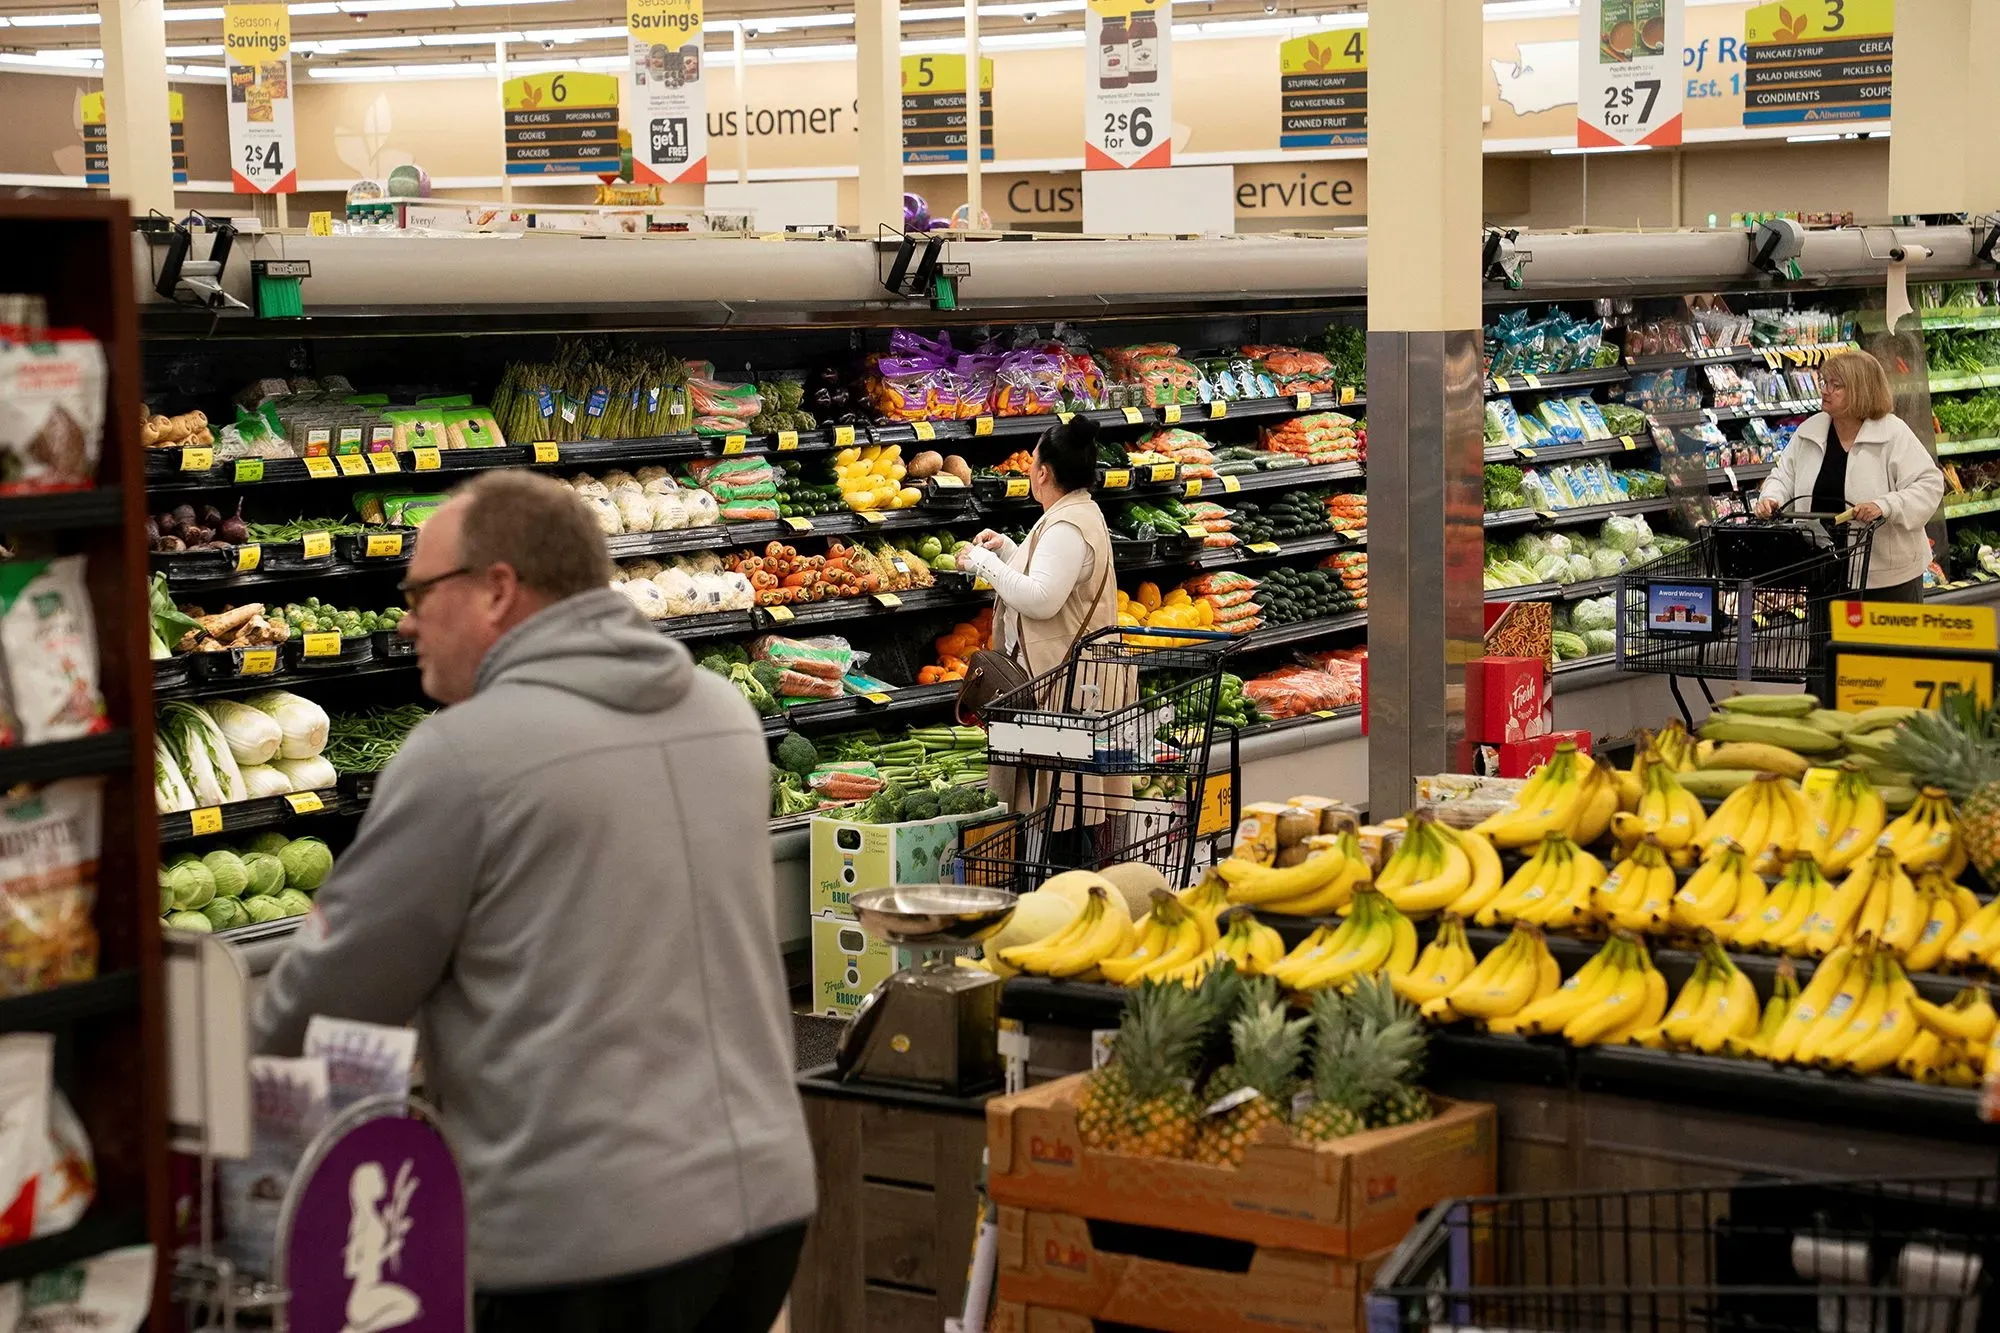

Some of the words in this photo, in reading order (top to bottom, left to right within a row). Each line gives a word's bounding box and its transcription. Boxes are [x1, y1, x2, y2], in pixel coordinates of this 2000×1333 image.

[233, 16, 271, 28] Season
[631, 10, 699, 32] Savings
[1823, 0, 1845, 32] 3
[227, 31, 287, 52] Savings
[1343, 32, 1364, 63] 4
[1683, 39, 1709, 72] of
[1756, 48, 1792, 59] PANCAKE
[1797, 47, 1824, 57] SYRUP
[918, 57, 934, 87] 5
[1756, 71, 1782, 82] SALAD
[1783, 69, 1822, 80] DRESSING
[1842, 65, 1874, 76] PICKLES
[551, 74, 567, 103] 6
[1287, 80, 1320, 89] STUFFING
[1323, 78, 1347, 87] GRAVY
[1687, 79, 1722, 98] Est.
[905, 99, 918, 108] OIL
[1289, 100, 1305, 108] CAN
[1305, 98, 1346, 107] VEGETABLES
[1757, 90, 1820, 104] CONDIMENTS
[514, 114, 529, 123] RICE
[529, 113, 551, 122] CAKES
[662, 118, 671, 132] 2
[1287, 119, 1322, 129] CANNED
[1323, 117, 1347, 127] FRUIT
[1603, 110, 1629, 126] for
[518, 131, 547, 141] COOKIES
[581, 129, 597, 138] AND
[652, 132, 674, 151] get
[674, 123, 684, 146] 1
[1104, 135, 1124, 149] for
[517, 149, 550, 158] CRACKERS
[578, 147, 601, 156] CANDY
[668, 146, 688, 157] FREE
[246, 163, 261, 175] for
[1679, 590, 1704, 599] Winning
[1870, 612, 1918, 627] Lower
[1922, 613, 1973, 630] Prices
[1512, 677, 1536, 710] Fresh
[821, 878, 841, 893] Fresh
[824, 979, 845, 994] Fresh
